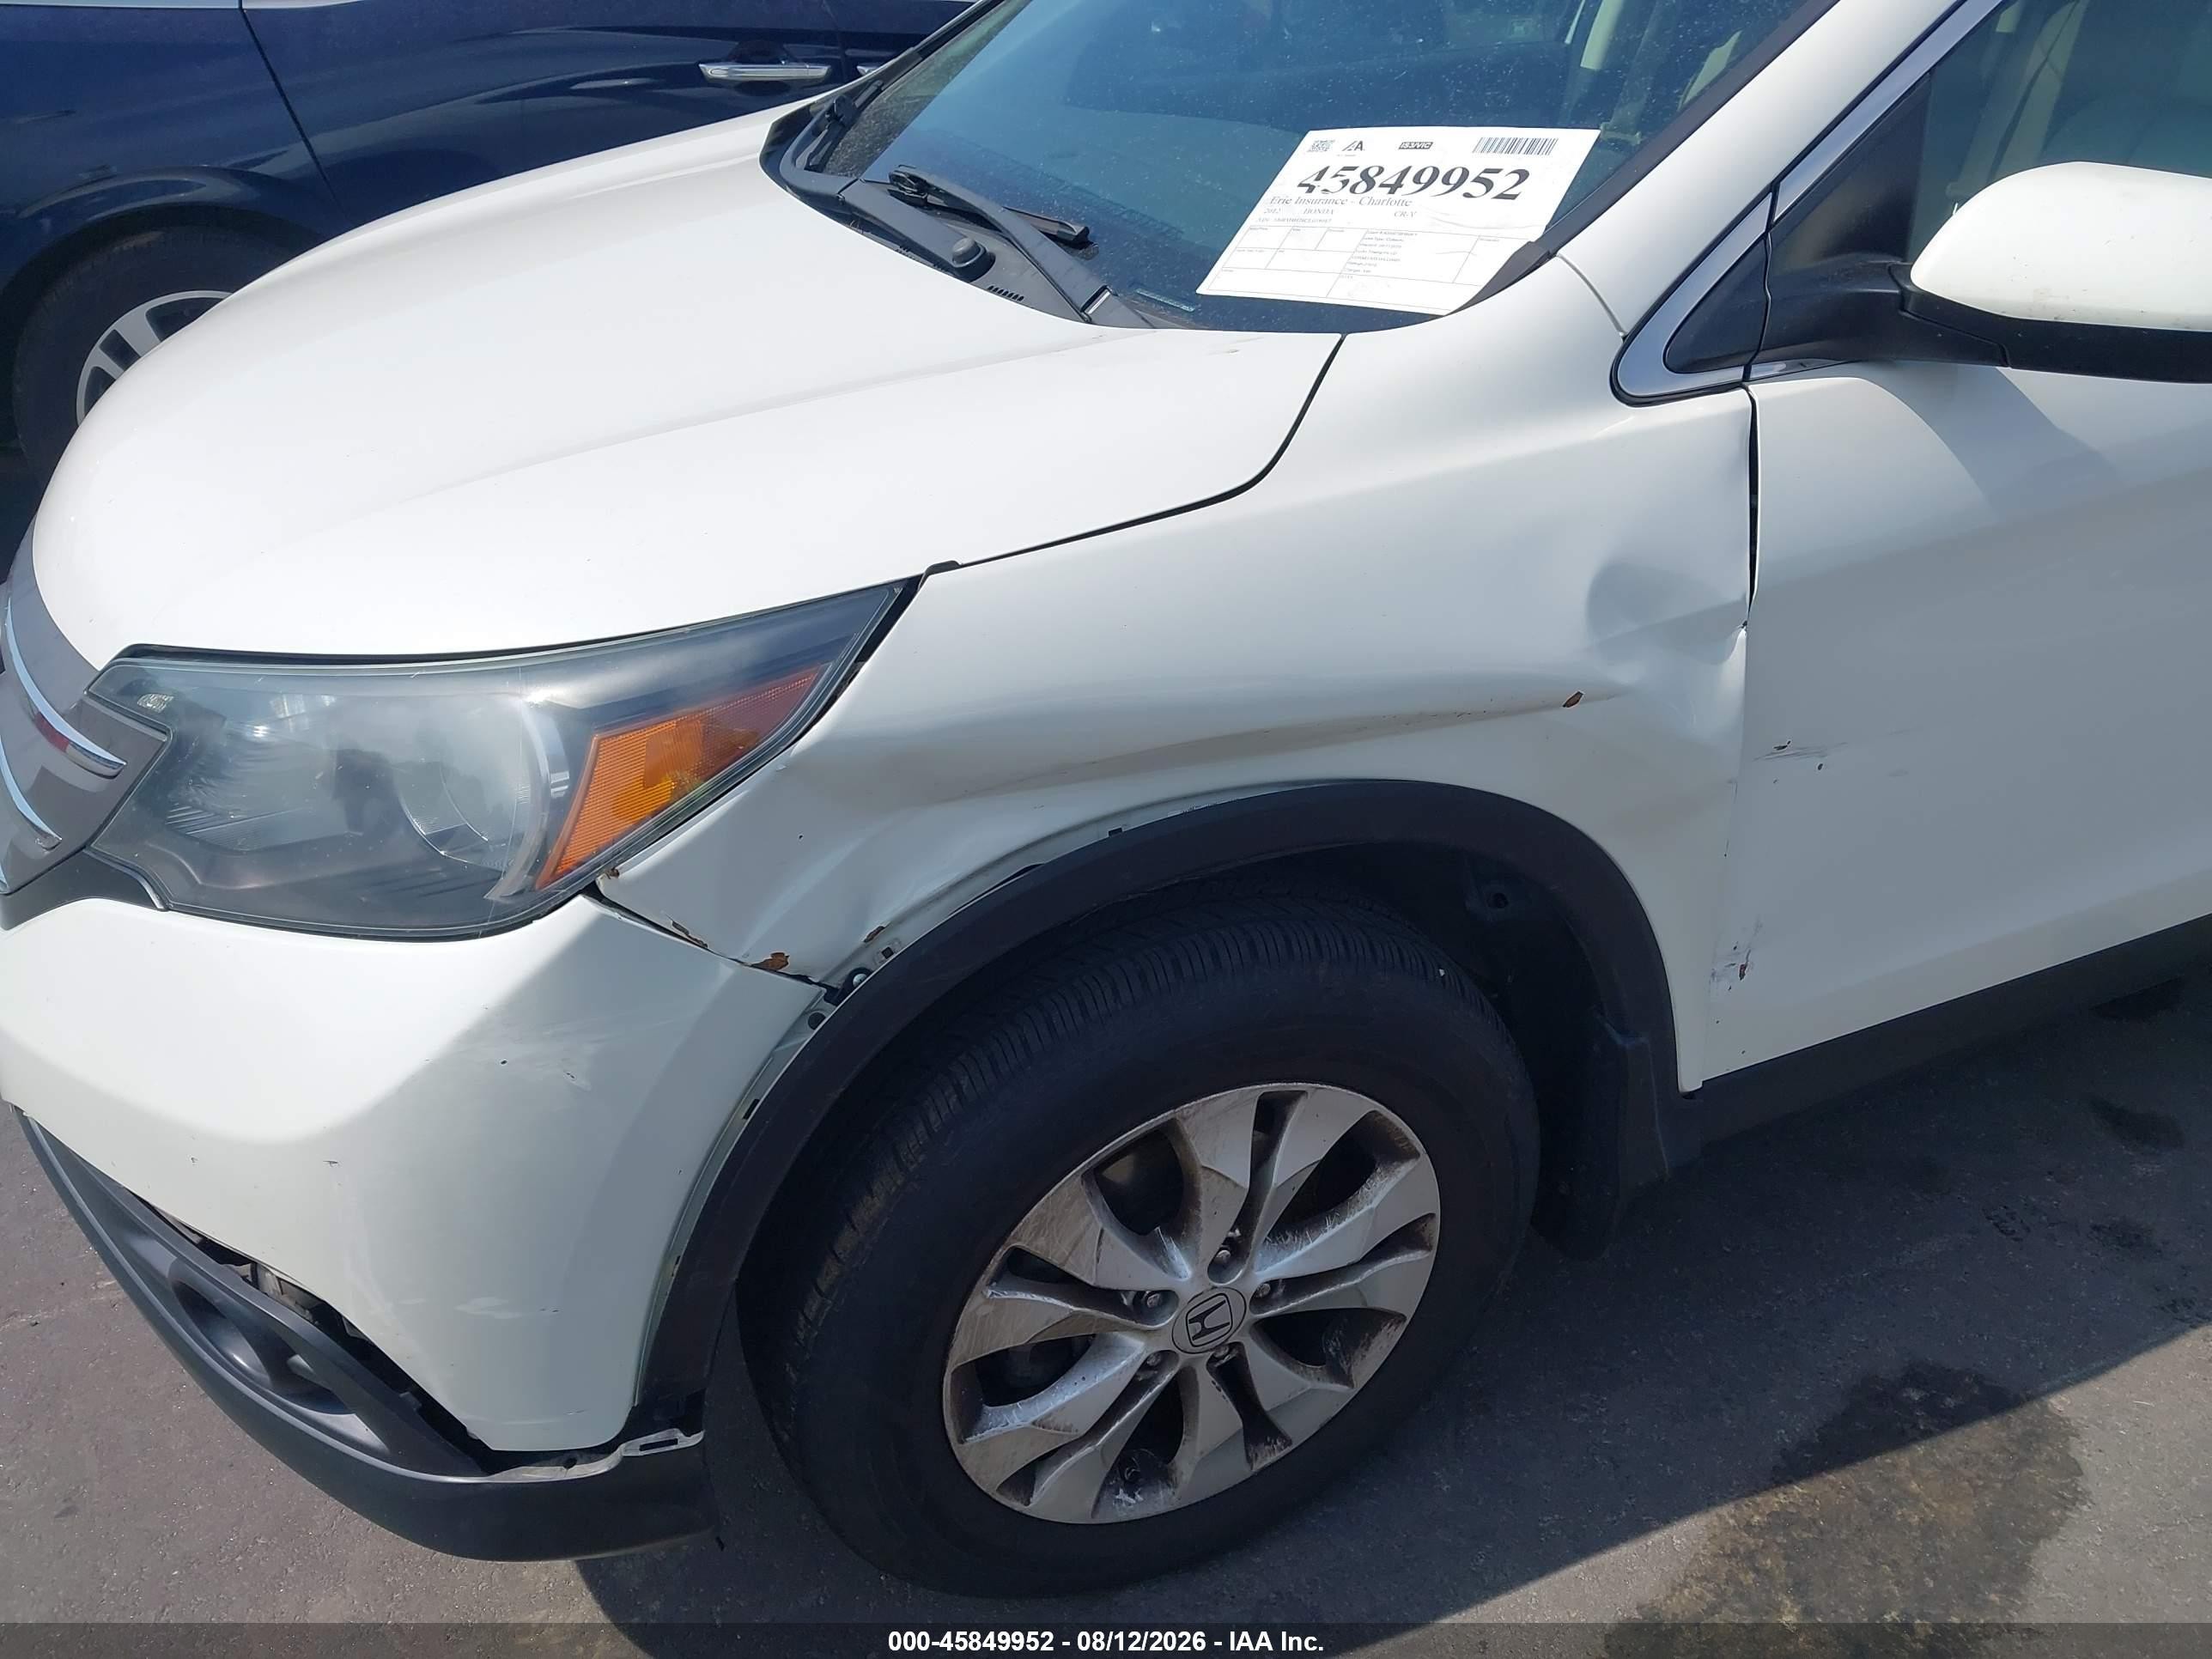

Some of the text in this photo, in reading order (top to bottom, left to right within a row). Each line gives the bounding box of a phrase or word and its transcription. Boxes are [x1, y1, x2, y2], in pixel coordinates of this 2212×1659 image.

[1297, 165, 1530, 200] 45849952
[1269, 196, 1292, 205] Erie
[1295, 197, 1347, 205] Insurance
[1358, 197, 1413, 207] Charlotte
